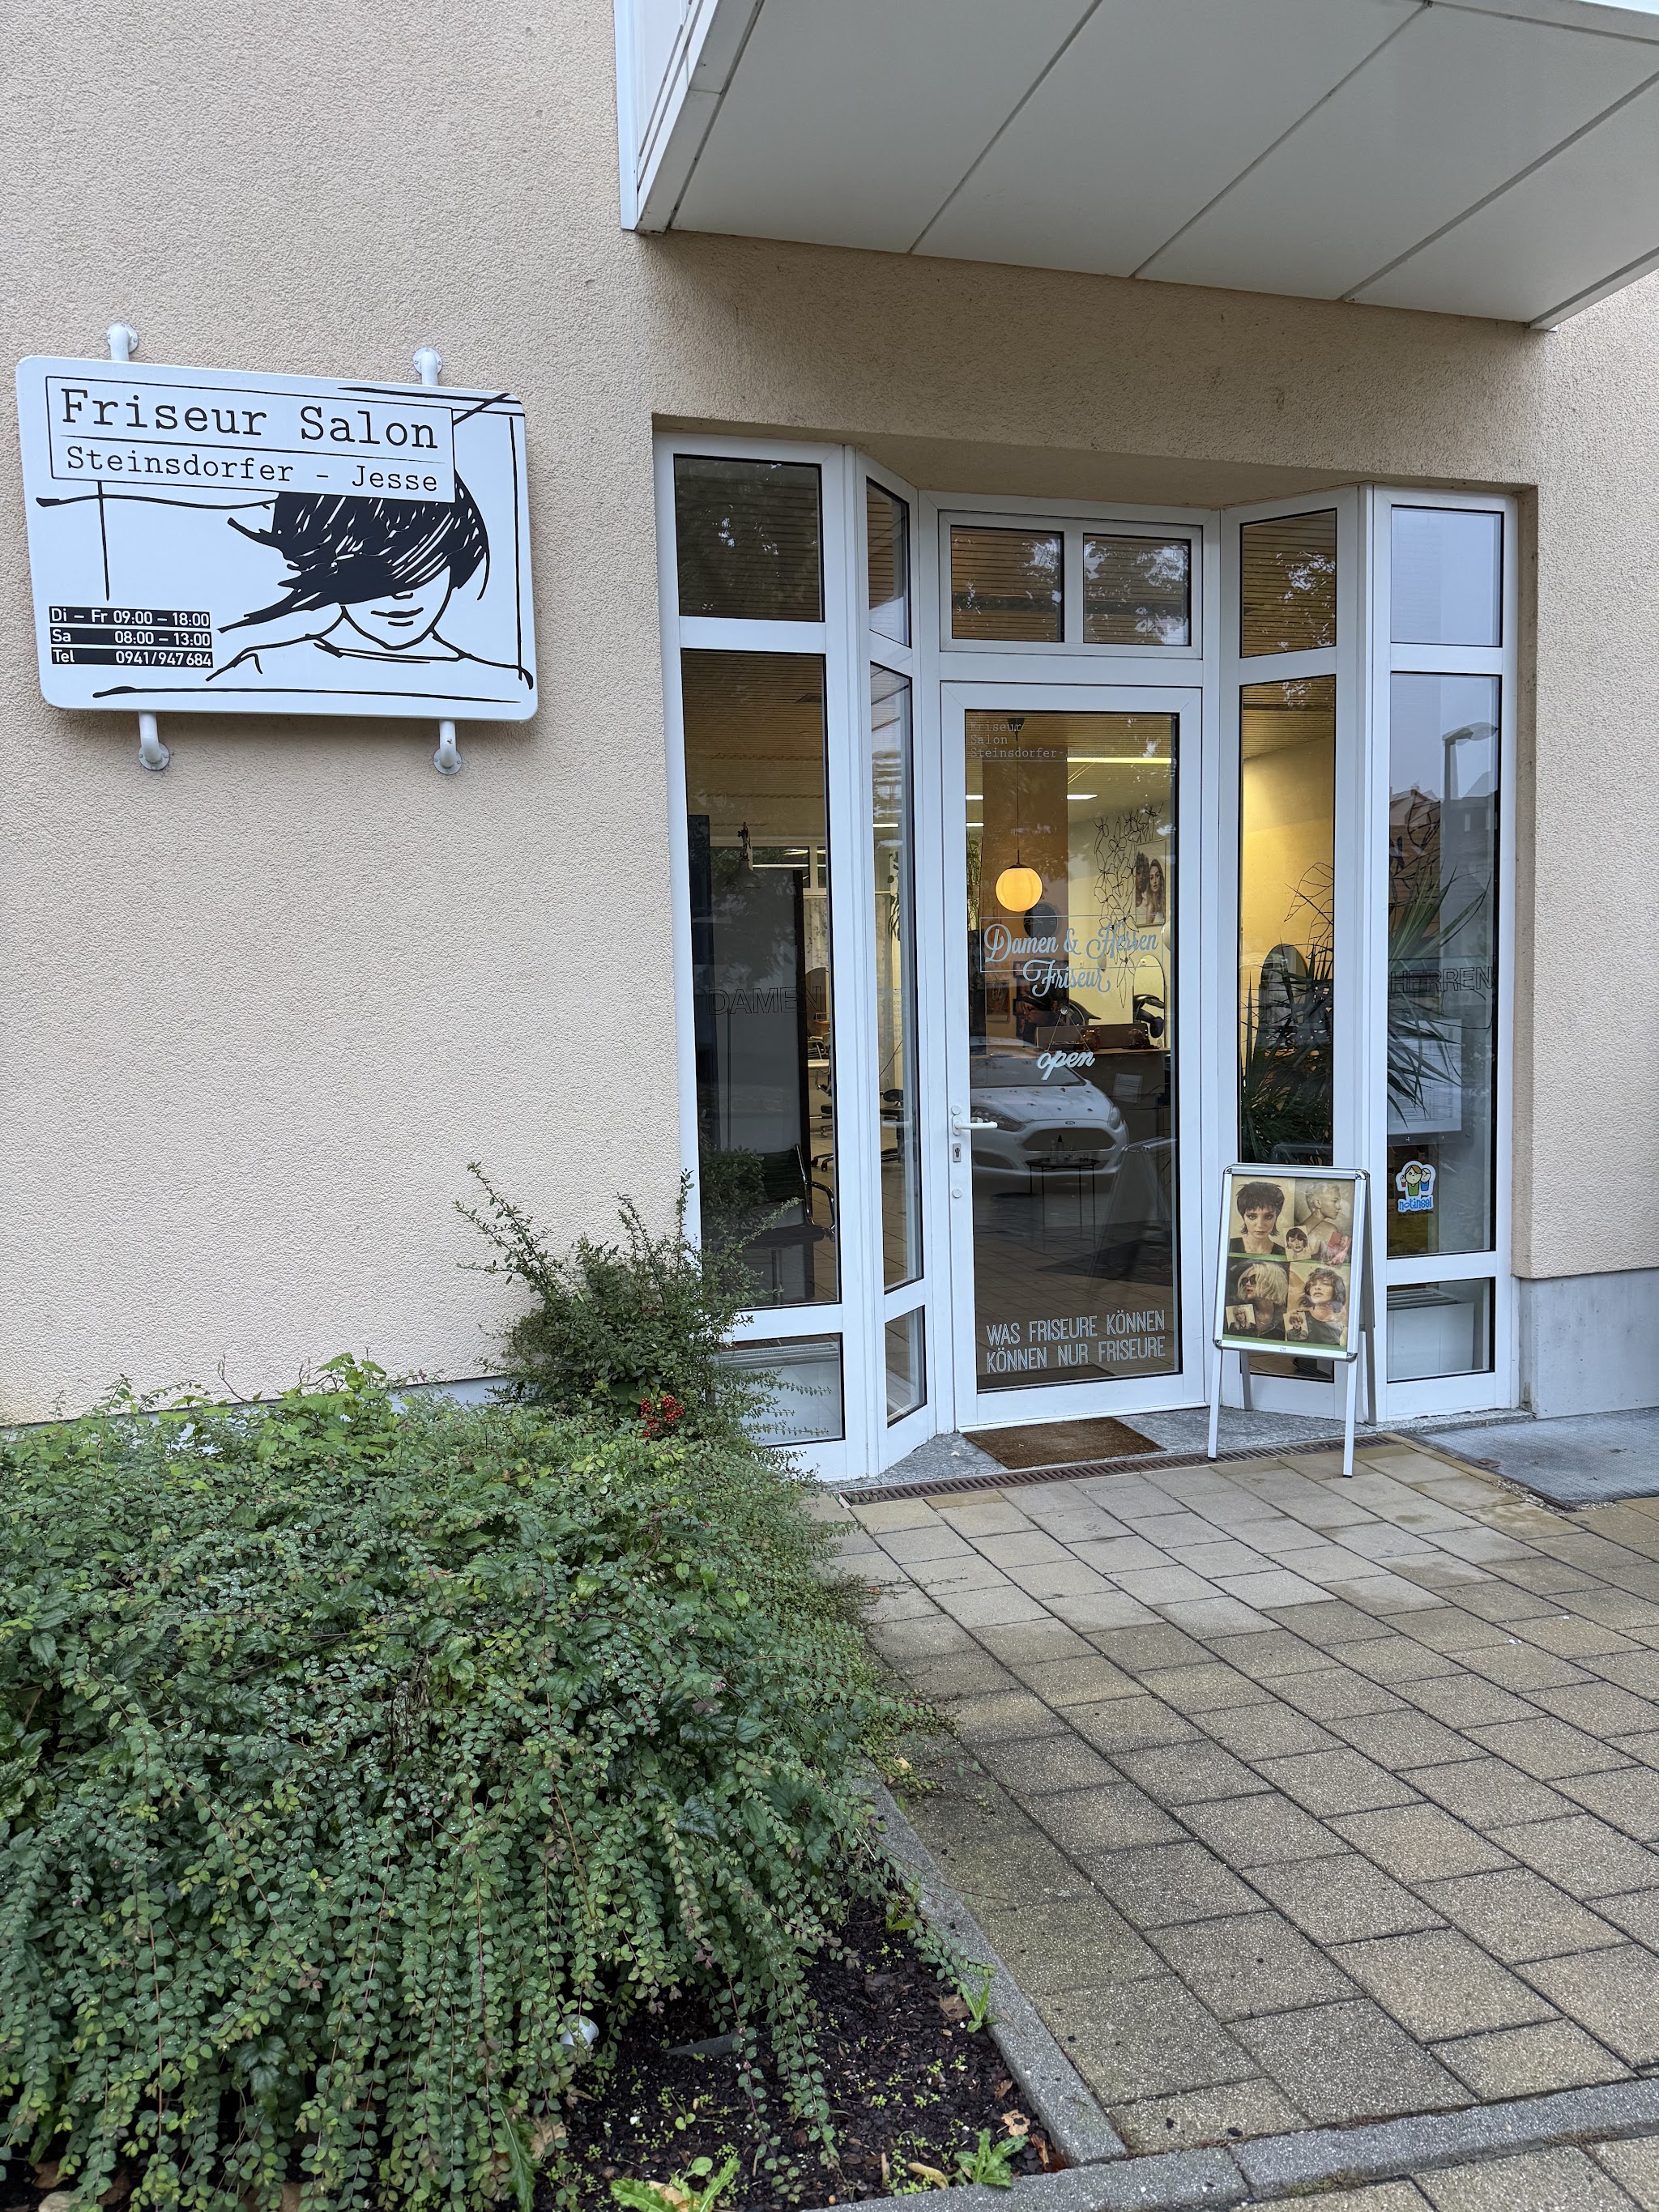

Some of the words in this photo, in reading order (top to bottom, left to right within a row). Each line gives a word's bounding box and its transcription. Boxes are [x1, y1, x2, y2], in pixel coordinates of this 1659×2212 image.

[61, 388, 267, 436] Friseur
[301, 406, 438, 449] Salon
[67, 445, 293, 482] Steinsdorfer
[352, 465, 437, 492] Jesse
[51, 607, 67, 622] Di
[91, 609, 108, 623] Fr
[113, 610, 153, 624] 09:00
[172, 612, 210, 627] 18:00
[52, 629, 71, 642] Sa
[114, 630, 154, 645] 08:00
[173, 633, 211, 646] 13:00
[53, 649, 75, 663] Tel
[970, 720, 1022, 731] Friseur
[970, 735, 1009, 744] Salon
[983, 923, 1058, 962] Damen
[1063, 928, 1081, 956] &
[1022, 959, 1111, 997] Friseur
[1390, 966, 1493, 994] HERREN
[708, 986, 822, 1016] DAMEN
[1036, 1050, 1095, 1080] open
[986, 1322, 1020, 1346] WAS
[1029, 1315, 1098, 1342] FRISEURE
[1106, 1309, 1165, 1336] KÖNNEN
[987, 1346, 1047, 1373] KÖNNEN
[1057, 1343, 1089, 1366] NUR
[1098, 1336, 1166, 1362] FRISEURE
